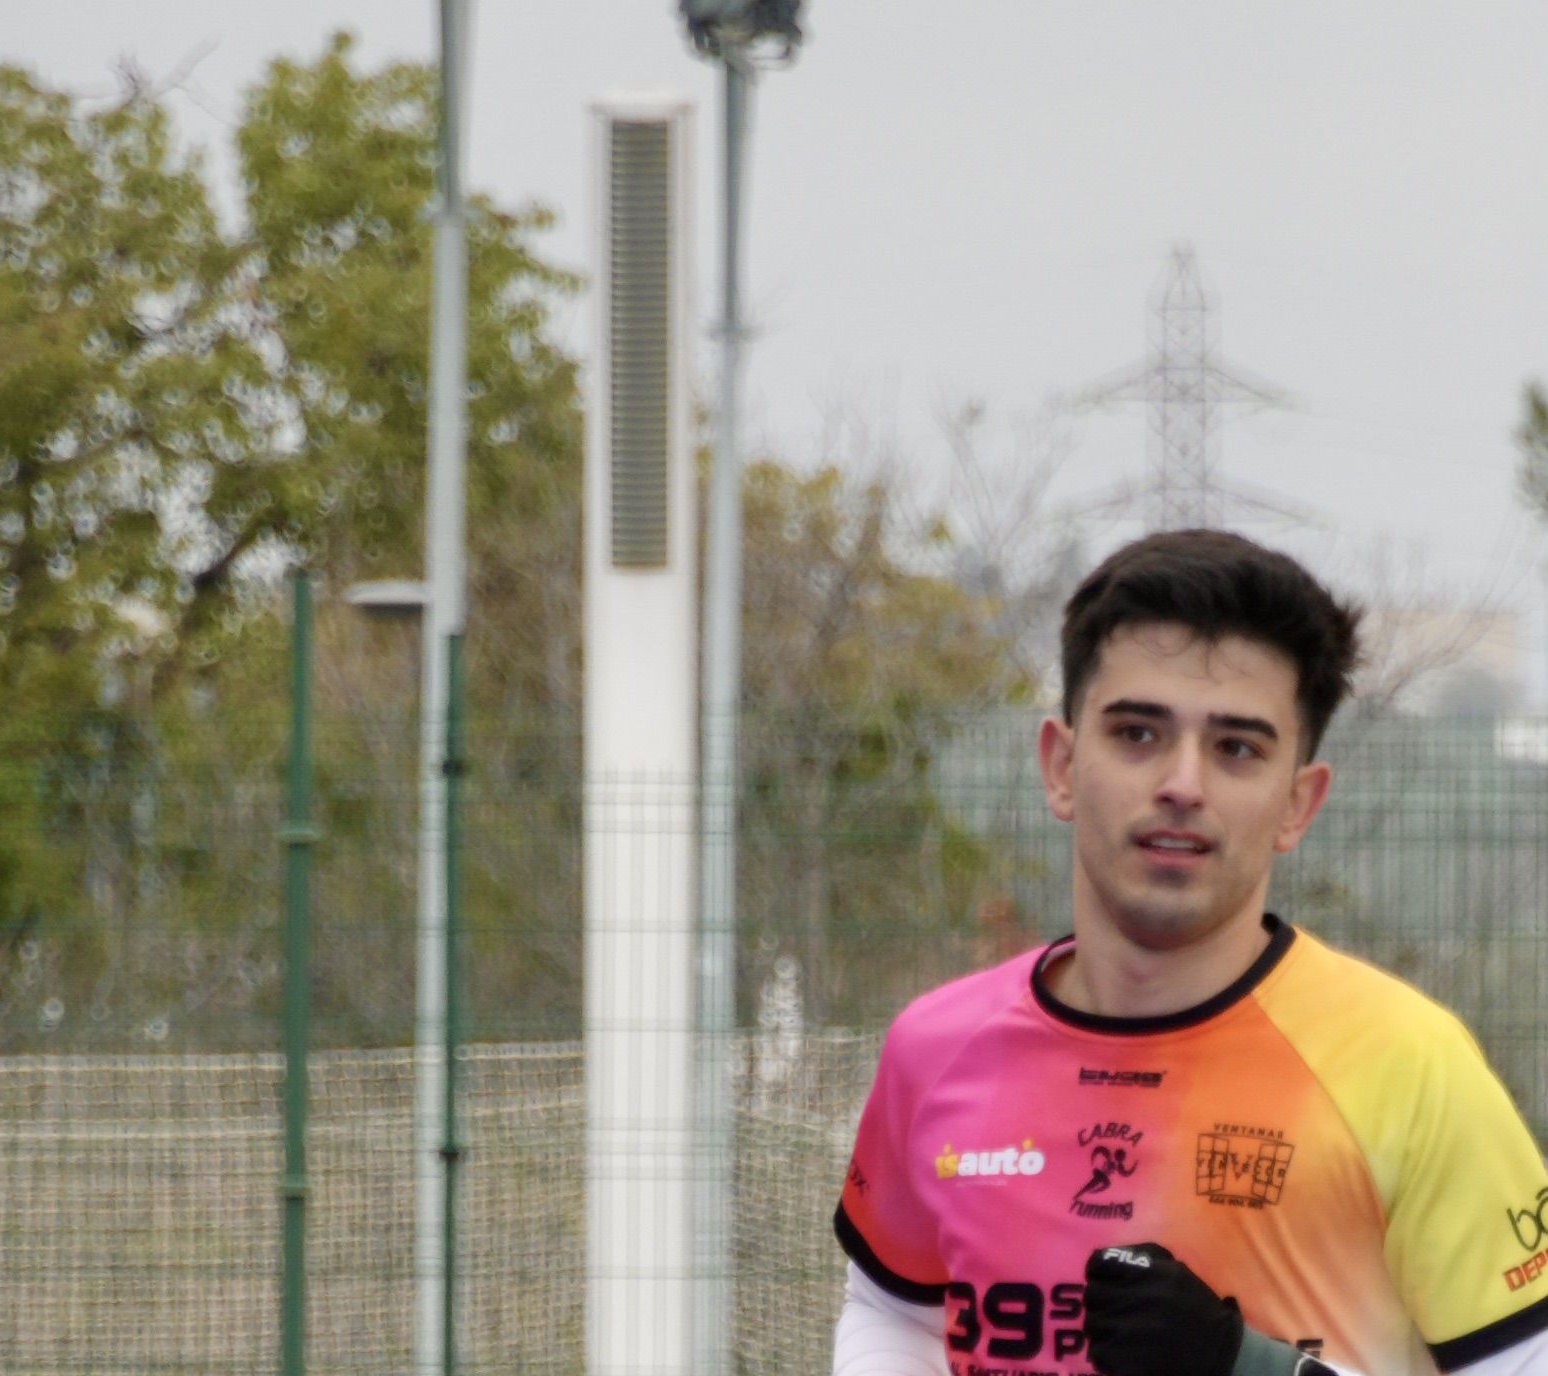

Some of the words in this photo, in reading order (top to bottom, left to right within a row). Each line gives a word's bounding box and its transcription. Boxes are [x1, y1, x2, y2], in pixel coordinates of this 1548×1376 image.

[1077, 1122, 1144, 1147] CABRA
[1068, 1199, 1135, 1221] running
[1103, 1247, 1151, 1268] FILA
[946, 1281, 1046, 1362] 39
